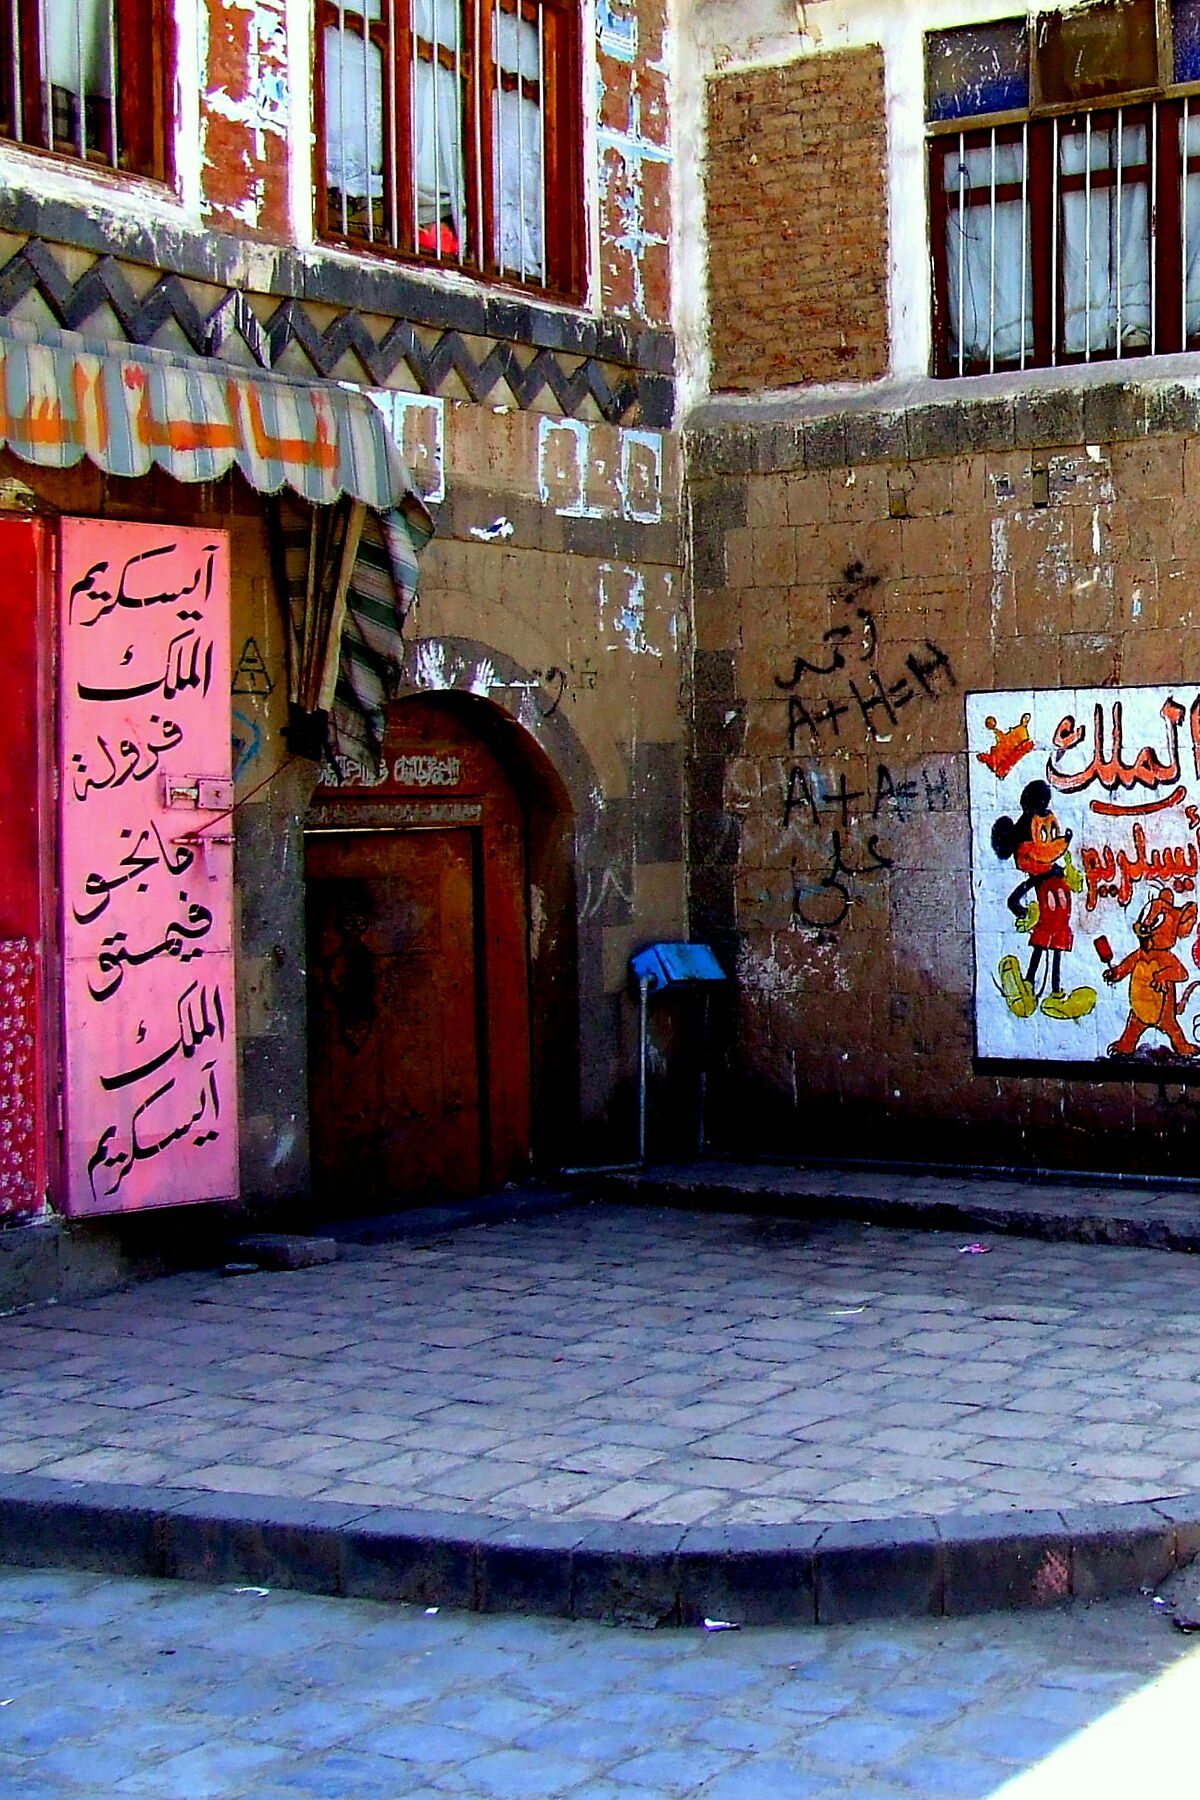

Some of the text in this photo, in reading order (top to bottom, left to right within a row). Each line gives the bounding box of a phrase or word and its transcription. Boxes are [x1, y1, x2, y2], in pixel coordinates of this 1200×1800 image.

[77, 628, 215, 701] الملك
[87, 890, 214, 1002] فيمتو
[99, 980, 226, 1091] الملك
